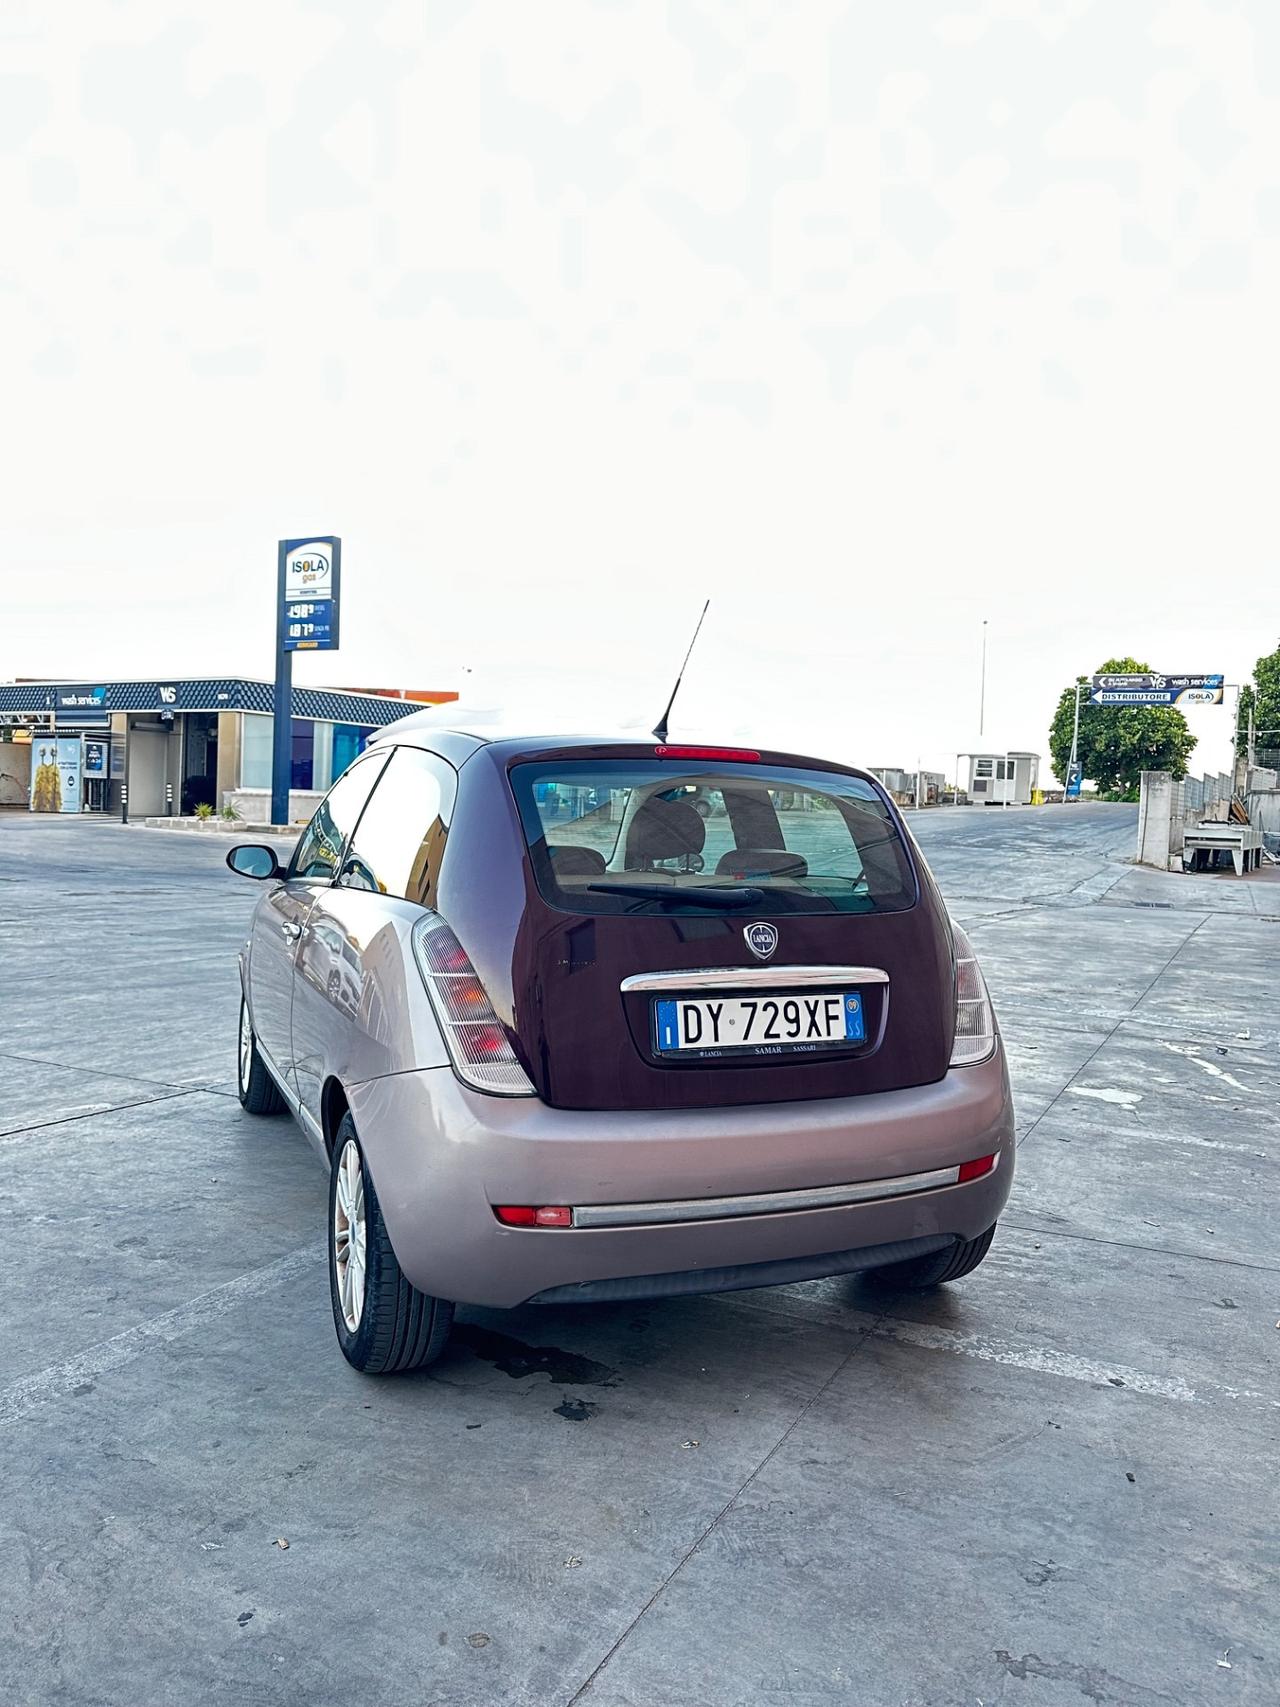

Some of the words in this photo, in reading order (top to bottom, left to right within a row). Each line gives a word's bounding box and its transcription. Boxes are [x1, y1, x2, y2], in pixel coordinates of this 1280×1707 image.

[292, 560, 324, 573] ISOLA
[302, 574, 316, 584] gas
[1171, 677, 1189, 686] wash
[1190, 677, 1218, 686] services
[61, 693, 77, 705] wash
[77, 694, 102, 705] services
[1102, 693, 1168, 701] DISTRIBUTORE
[752, 934, 773, 943] LANCIA
[683, 1003, 723, 1044] DY
[741, 999, 841, 1041] 729XF
[848, 1021, 861, 1037] SS
[755, 1046, 782, 1055] SAMAR
